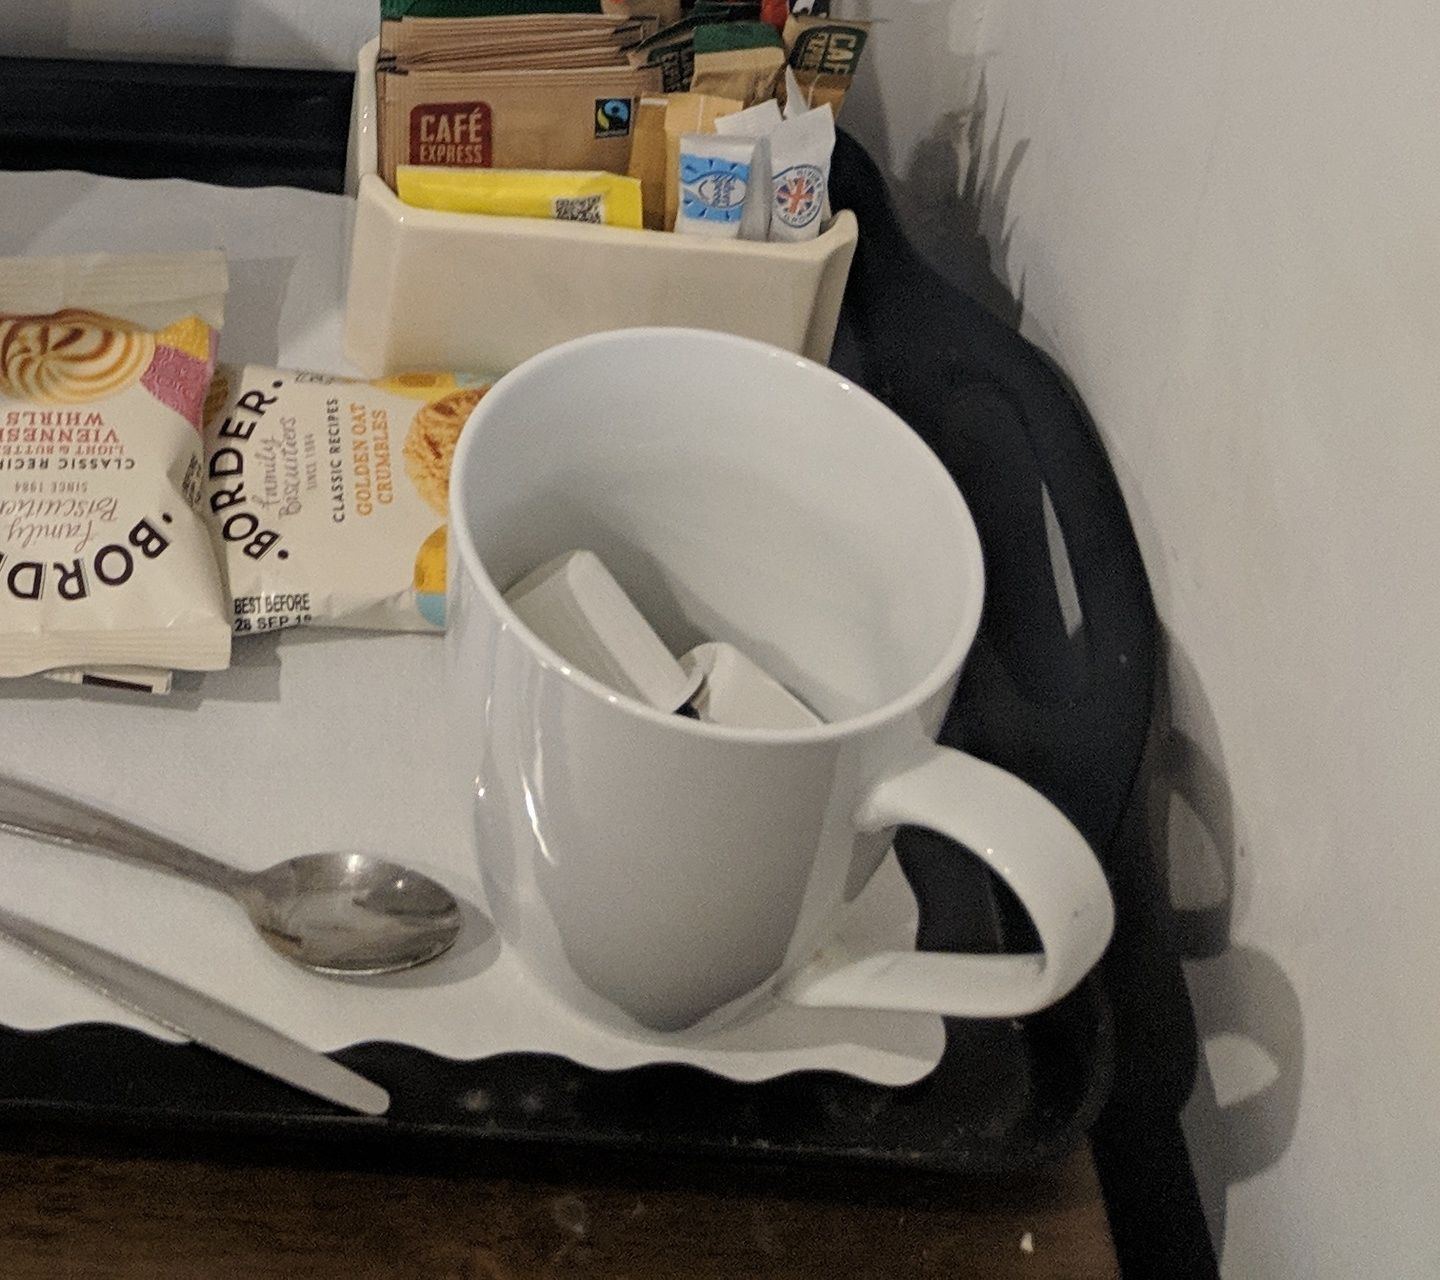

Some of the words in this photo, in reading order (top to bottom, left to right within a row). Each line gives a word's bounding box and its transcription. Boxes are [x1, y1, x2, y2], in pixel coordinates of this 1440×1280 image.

[420, 107, 482, 143] CAFÉ
[420, 143, 482, 163] EXPRESS
[6, 411, 105, 427] WHIRLS
[326, 397, 341, 455] RECIPES
[350, 402, 366, 435] OAT
[60, 445, 70, 454] &
[75, 444, 125, 455] LIGHT
[371, 409, 393, 506] CRUMBLES
[59, 459, 136, 470] CLASSIC
[14, 481, 43, 492] 1984
[53, 482, 88, 493] SINCE
[352, 438, 373, 517] GOLDEN
[329, 458, 345, 524] CLASSIC
[234, 595, 261, 615] BEST
[265, 593, 310, 613] BEFORE
